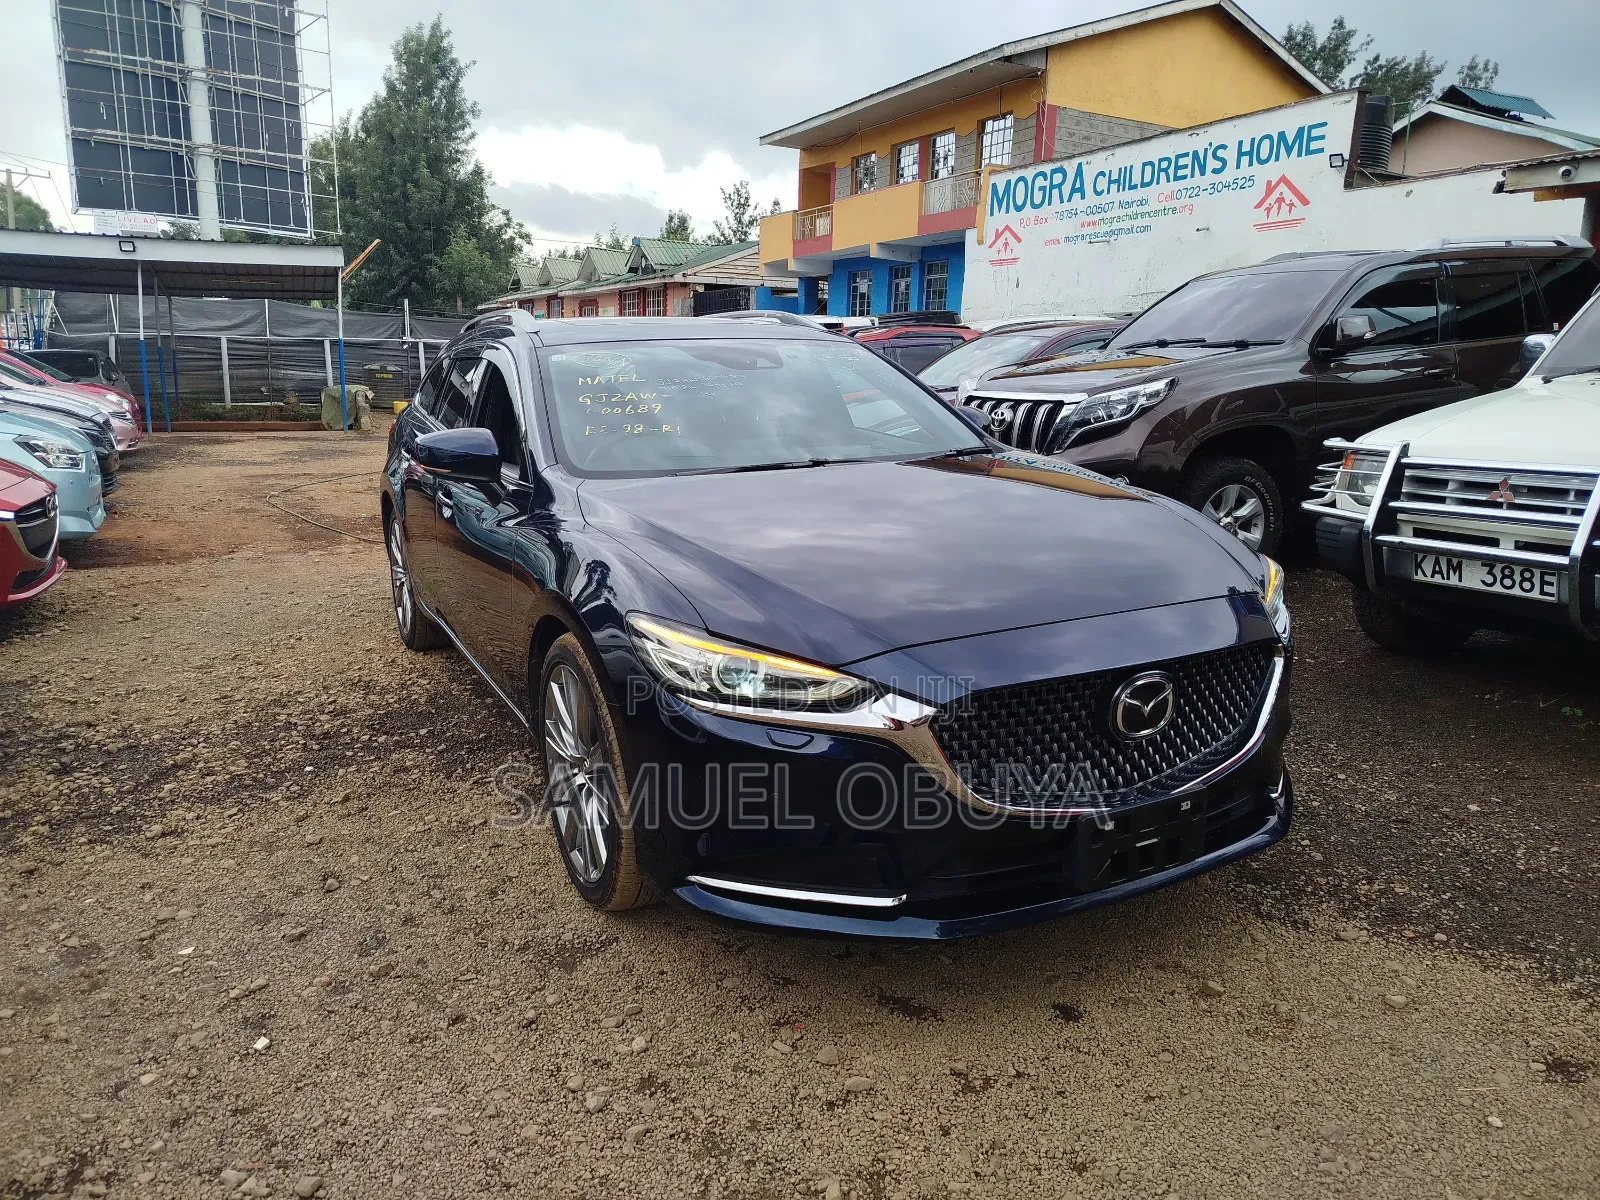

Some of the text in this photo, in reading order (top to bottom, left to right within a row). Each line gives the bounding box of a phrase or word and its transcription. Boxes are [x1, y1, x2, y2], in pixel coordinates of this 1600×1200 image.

[989, 121, 1328, 217] MOGRA CHILDREN'S HOME
[1033, 215, 1049, 226] Box
[1414, 554, 1557, 598] KAM 388E
